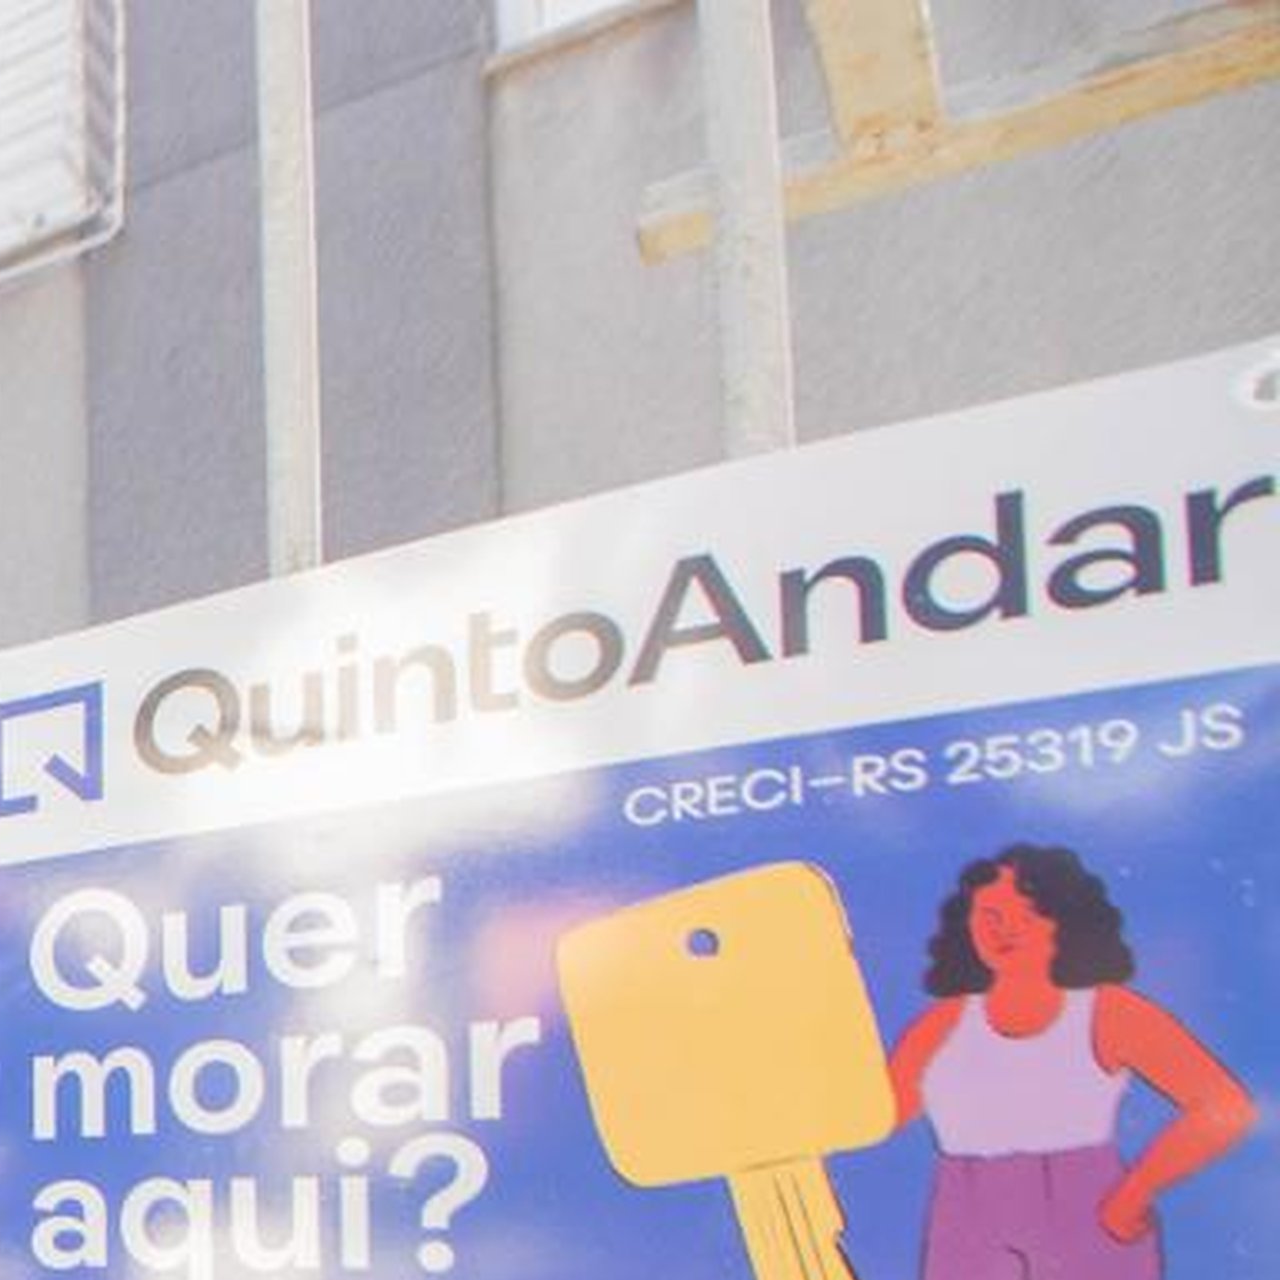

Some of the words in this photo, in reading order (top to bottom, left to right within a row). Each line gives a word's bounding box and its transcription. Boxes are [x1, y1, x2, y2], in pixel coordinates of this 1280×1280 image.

[132, 473, 1276, 777] QuintoAndar
[944, 718, 1140, 785] 25319
[1157, 704, 1246, 757] JS
[28, 874, 443, 1012] Quer
[31, 1016, 541, 1141] morar
